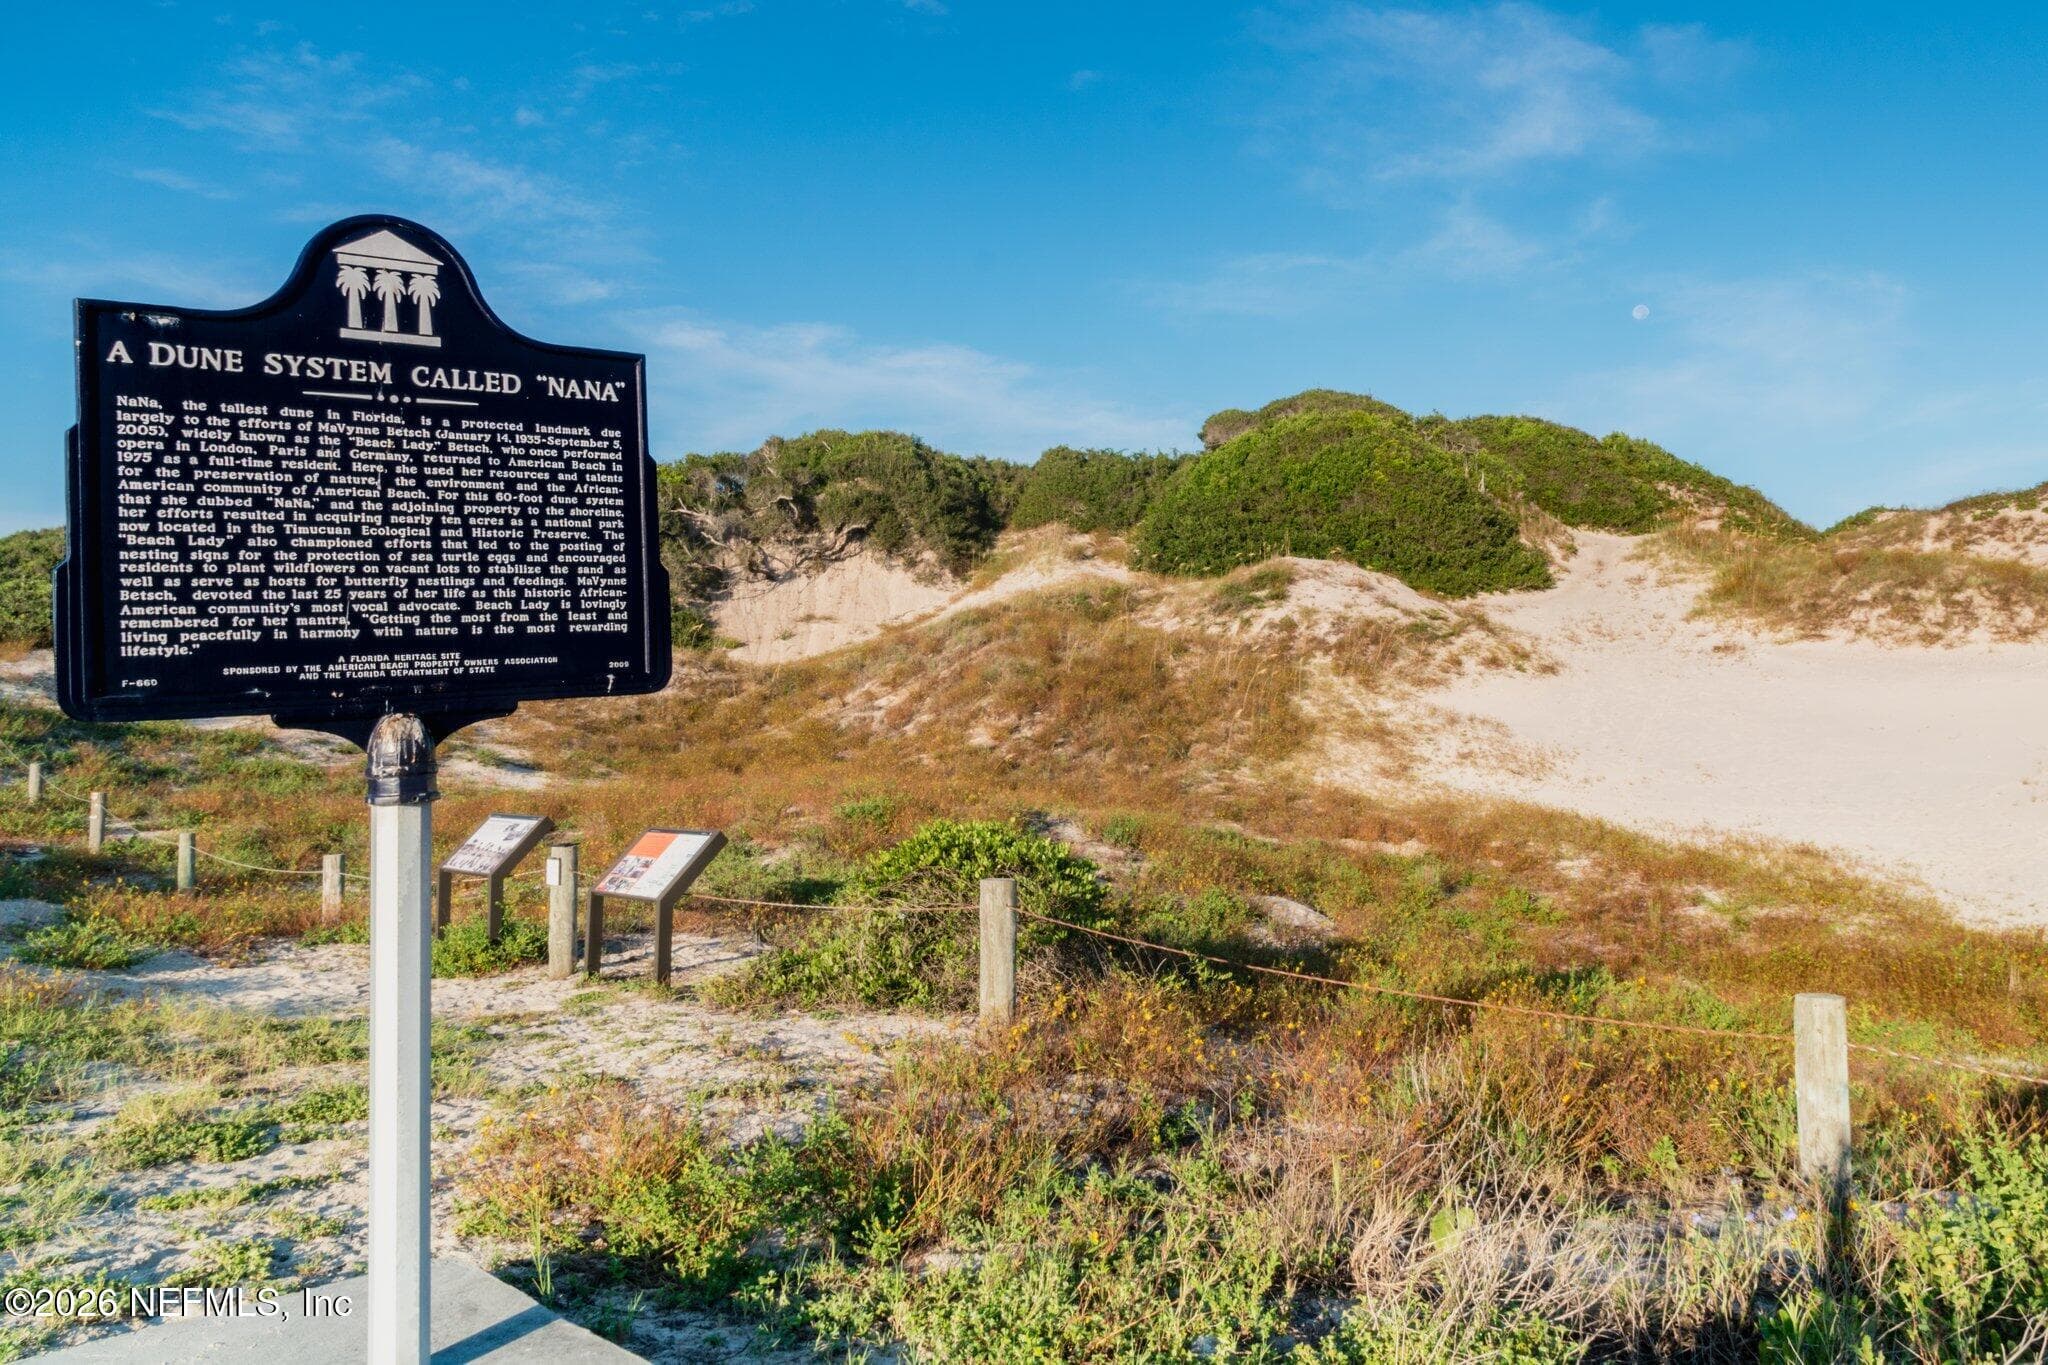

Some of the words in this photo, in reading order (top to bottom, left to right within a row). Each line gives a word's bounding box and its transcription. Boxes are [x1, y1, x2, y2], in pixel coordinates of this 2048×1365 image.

[106, 340, 134, 364] A
[149, 341, 244, 373] DUNE
[263, 353, 394, 384] SYSTEM
[411, 365, 522, 394] CALLED
[116, 394, 162, 409] NaNa,
[182, 399, 207, 411] the
[220, 402, 268, 415] tallest
[279, 406, 314, 418] dune
[326, 408, 340, 419] in
[352, 410, 405, 425] Florida,
[420, 415, 432, 425] is
[442, 418, 450, 427] a
[461, 419, 523, 431] protected
[535, 423, 590, 436] landmark
[600, 428, 621, 437] due
[116, 439, 164, 450] opera
[175, 440, 190, 451] in
[200, 440, 257, 455] London,
[269, 444, 306, 456] Paris
[316, 448, 340, 458] and
[348, 448, 413, 463] Germany,
[423, 454, 480, 464] returned
[487, 456, 500, 465] to
[508, 456, 565, 468] American
[571, 460, 606, 471] Beach
[612, 461, 622, 471] in
[116, 450, 152, 463] 1975
[162, 455, 180, 464] as
[188, 456, 198, 464] a
[208, 455, 273, 467] full-time
[281, 459, 341, 470] resident.
[352, 461, 387, 475] Here,
[395, 464, 417, 474] she
[423, 466, 454, 475] used
[461, 466, 483, 476] her
[489, 469, 549, 479] resources
[557, 471, 577, 481] and
[585, 472, 623, 482] talents
[117, 478, 194, 491] American
[202, 483, 282, 495] community
[291, 484, 307, 495] of
[314, 485, 381, 497] American
[387, 487, 430, 499] Beach.
[437, 489, 459, 500] For
[464, 491, 488, 501] this
[495, 491, 542, 503] 60-foot
[550, 494, 578, 504] dune
[585, 496, 624, 506] system
[117, 492, 151, 504] that
[160, 494, 187, 505] she
[196, 495, 252, 507] dubbed
[330, 500, 354, 510] and
[360, 500, 383, 510] the
[391, 501, 454, 515] adjoining
[463, 504, 520, 516] property
[527, 505, 539, 514] to
[545, 505, 564, 515] the
[569, 506, 624, 517] shoreline,
[118, 522, 150, 531] now
[157, 521, 216, 532] located
[226, 522, 241, 533] in
[250, 522, 274, 533] the
[282, 523, 351, 535] Timucuan
[361, 524, 430, 538] Ecological
[440, 527, 463, 537] and
[471, 527, 524, 538] Historic
[533, 528, 590, 539] Preserve.
[602, 530, 624, 539] The
[247, 536, 277, 546] also
[290, 536, 372, 549] championed
[384, 537, 432, 548] efforts
[441, 538, 468, 549] that
[478, 539, 497, 549] led
[508, 541, 521, 550] to
[529, 541, 549, 550] the
[559, 541, 602, 553] posting
[612, 542, 625, 551] of
[119, 548, 178, 562] nesting
[190, 549, 229, 562] signs
[238, 549, 261, 560] for
[273, 549, 297, 560] the
[306, 550, 380, 562] protection
[388, 550, 403, 561] of
[410, 552, 433, 561] sea
[441, 551, 479, 561] turtle
[487, 553, 515, 564] eggs
[526, 553, 548, 562] and
[557, 553, 625, 564] encouraged
[119, 575, 153, 587] well
[163, 577, 180, 586] as
[190, 577, 233, 586] serve
[243, 577, 260, 586] as
[268, 575, 306, 586] hosts
[316, 575, 337, 586] for
[344, 575, 408, 588] butterfly
[417, 575, 475, 588] nestlings
[482, 576, 505, 586] and
[512, 575, 566, 588] feedings.
[577, 575, 626, 587] MaVynne
[119, 589, 176, 601] Betsch,
[192, 589, 252, 600] devoted
[262, 589, 285, 599] the
[291, 588, 318, 599] last
[324, 588, 341, 599] 25
[348, 590, 386, 600] years
[393, 588, 408, 598] of
[414, 588, 438, 598] her
[443, 587, 465, 598] life
[472, 589, 486, 597] as
[492, 587, 516, 598] this
[524, 587, 571, 597] historic
[579, 587, 627, 597] African-
[120, 631, 167, 644] living
[179, 629, 261, 643] peacefully
[273, 628, 288, 639] in
[299, 625, 360, 639] harmony
[372, 625, 402, 636] with
[415, 626, 458, 635] nature
[471, 624, 482, 634] is
[493, 624, 514, 634] the
[526, 623, 555, 633] most
[569, 621, 627, 633] rewarding
[222, 665, 280, 675] SPONSORED
[285, 665, 298, 673] BY
[303, 664, 321, 672] THE
[327, 662, 376, 671] AMERICAN
[380, 661, 409, 670] BEACH
[414, 659, 460, 668] PROPERTY
[463, 658, 498, 667] OWNERS
[504, 656, 558, 665] ASSOCIATION
[338, 655, 345, 663] A
[350, 654, 390, 663] FLORIDA
[394, 653, 436, 661] HERITAGE
[440, 652, 460, 660] SITE
[608, 661, 629, 669] 2009
[298, 672, 319, 680] AND
[323, 671, 341, 679] THE
[346, 670, 386, 679] FLORIDA
[390, 668, 448, 677] DEPARTMENT
[452, 667, 464, 675] OF
[468, 666, 495, 675] STATE
